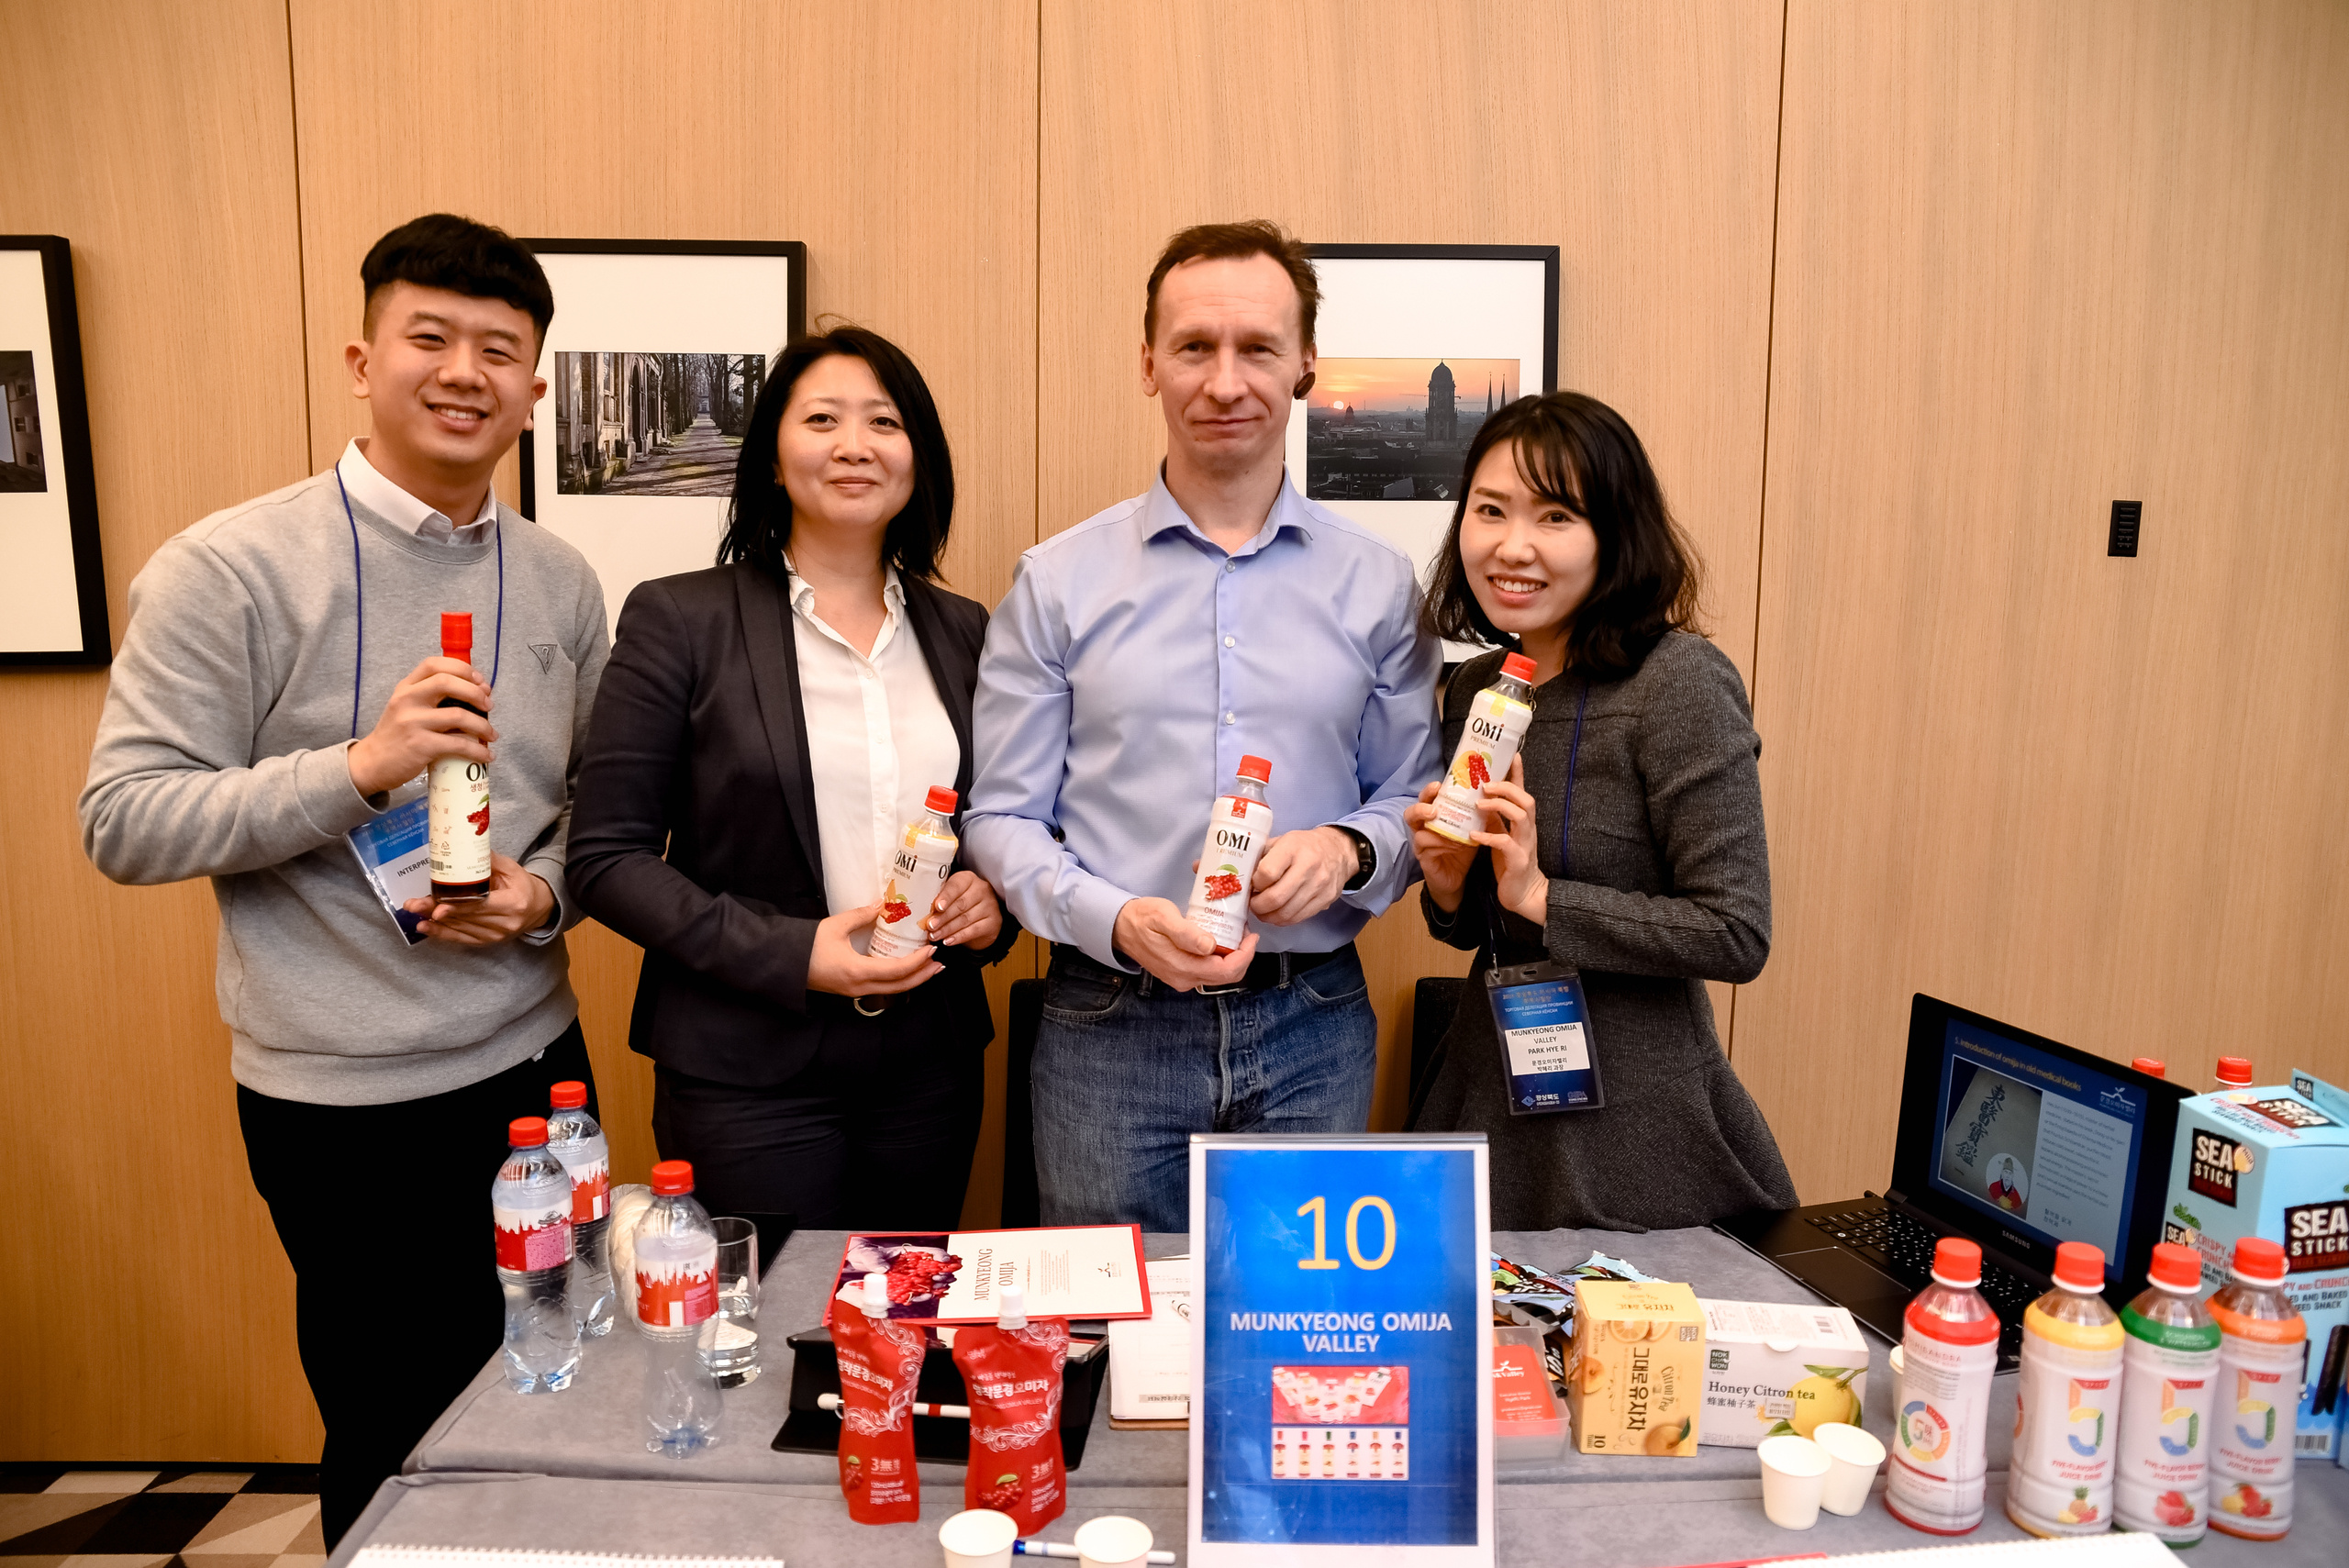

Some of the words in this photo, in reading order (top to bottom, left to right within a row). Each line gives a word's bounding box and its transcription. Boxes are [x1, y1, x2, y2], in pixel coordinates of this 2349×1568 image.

[396, 857, 430, 877] INTERPRE
[1511, 1026, 1554, 1037] MUNKYEONG
[1555, 1024, 1577, 1032] OMIJA
[1533, 1036, 1557, 1044] VALLEY
[2001, 1055, 2020, 1069] omija
[2025, 1063, 2037, 1074] old
[2036, 1067, 2062, 1084] medical
[2061, 1076, 2082, 1093] books
[2296, 1079, 2312, 1092] SEA
[2195, 1135, 2233, 1172] SEA
[2194, 1161, 2233, 1189] STICK
[2290, 1206, 2349, 1239] SEA
[1297, 1195, 1397, 1271] 10
[2001, 1229, 2032, 1250] SAMSUNG
[2167, 1225, 2186, 1245] SEA
[2197, 1232, 2227, 1255] CRISPY
[2289, 1235, 2349, 1257] STICK
[2197, 1246, 2234, 1272] CRUNCH
[974, 1248, 993, 1301] MUNKYEONG
[998, 1261, 1018, 1286] OMIJA
[2211, 1267, 2224, 1277] AND
[2313, 1275, 2349, 1289] CRUNC
[2302, 1294, 2319, 1302] AND
[2321, 1290, 2348, 1300] BAKED
[2313, 1300, 2342, 1310] SNACK
[1230, 1312, 1375, 1332] MUNKYEONG
[1381, 1312, 1453, 1332] OMIJA
[1301, 1333, 1380, 1353] VALLEY
[1661, 1366, 1675, 1396] Citron
[1709, 1381, 1750, 1397] Honey
[1753, 1385, 1793, 1398] Citron
[1798, 1390, 1815, 1400] tea
[1707, 1396, 1756, 1409] 蜂蜜柚子茶
[1594, 1435, 1606, 1449] 10
[2059, 1471, 2081, 1481] JUICE
[2083, 1472, 2102, 1481] DRINK
[2226, 1461, 2248, 1472] JUICE
[2153, 1472, 2176, 1482] JUICE
